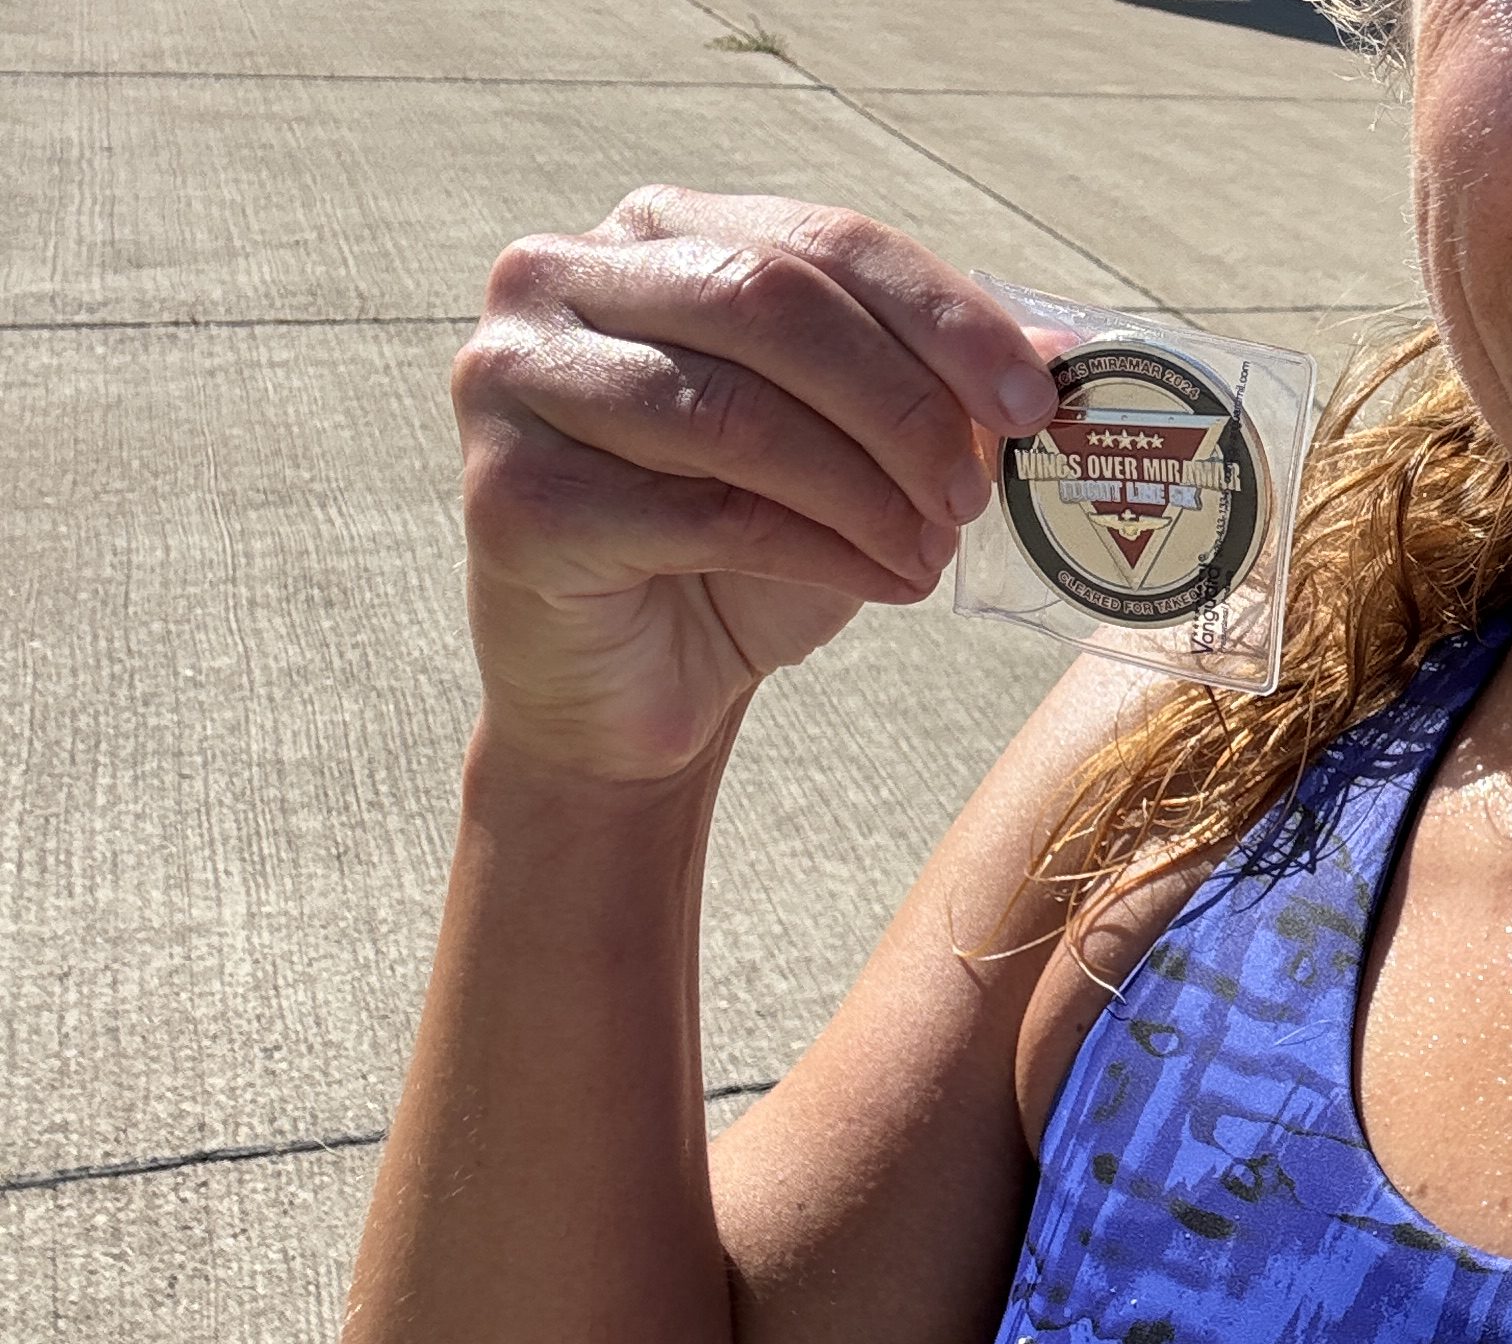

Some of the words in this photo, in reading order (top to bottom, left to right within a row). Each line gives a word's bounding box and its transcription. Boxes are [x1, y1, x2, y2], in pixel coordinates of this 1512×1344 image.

[1088, 356, 1163, 380] MIRAMAR
[1162, 369, 1201, 401] 2024
[1014, 448, 1083, 481] WINGS
[1087, 454, 1138, 480] OVER
[1142, 457, 1242, 493] MIRAMAR
[1126, 481, 1166, 505] LINE
[1057, 570, 1122, 611] CLEARED
[1123, 601, 1154, 616] FOR
